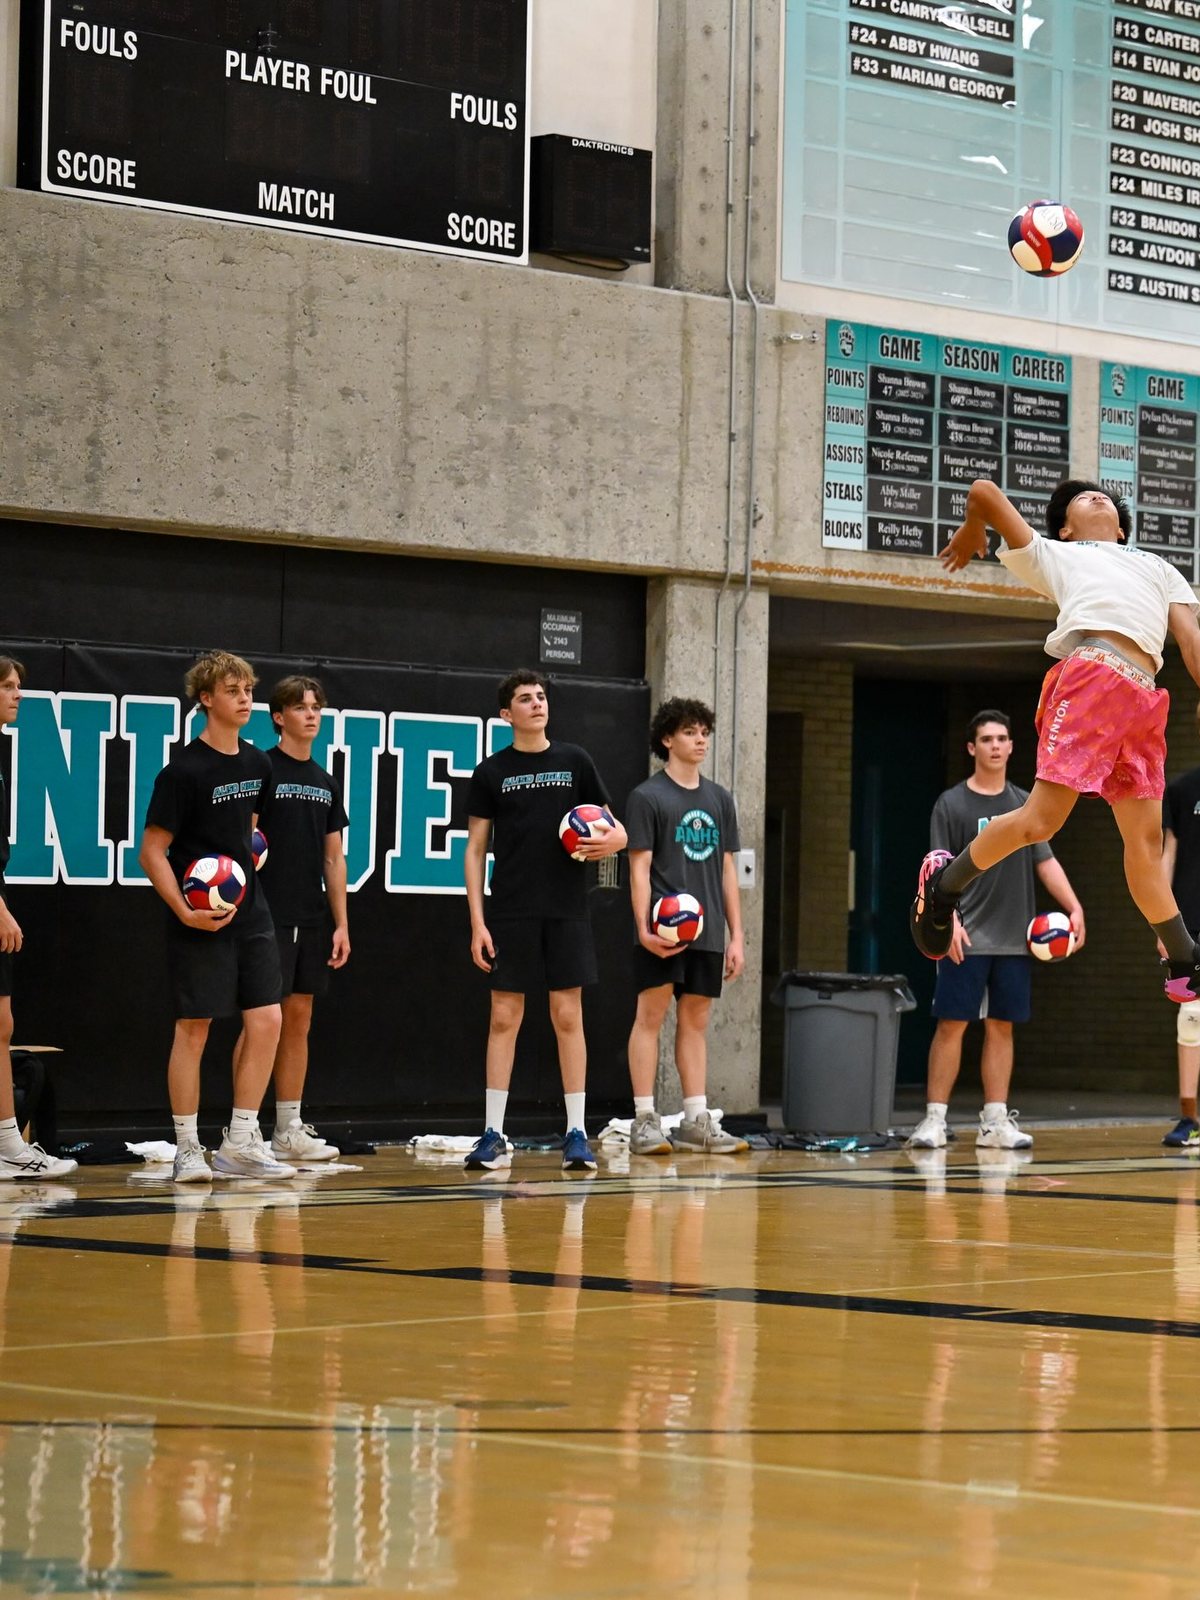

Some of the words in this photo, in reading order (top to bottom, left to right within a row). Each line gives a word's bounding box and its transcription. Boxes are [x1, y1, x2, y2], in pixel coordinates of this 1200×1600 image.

[890, 0, 949, 24] CAMRY
[61, 19, 138, 60] FOULS
[851, 26, 877, 44] #24
[889, 36, 926, 55] ABBY
[930, 44, 979, 66] HWANG
[1115, 22, 1139, 38] #13
[1145, 28, 1200, 53] CARTER
[1114, 50, 1137, 68] #14
[1144, 56, 1180, 77] EVAN
[226, 50, 310, 92] PLAYER
[321, 68, 377, 104] FOUL
[853, 57, 878, 74] #33
[891, 64, 946, 88] MARIAM
[949, 77, 1005, 100] GEORGY
[1114, 84, 1137, 101] #20
[451, 92, 517, 130] FOULS
[1114, 112, 1135, 129] #21
[1143, 119, 1180, 139] JOSH
[572, 138, 634, 156] DAKTRONICS
[1112, 147, 1135, 164] #23
[57, 150, 136, 189] SCORE
[1112, 176, 1135, 193] #24
[1142, 180, 1183, 201] MILES
[258, 182, 334, 220] MATCH
[447, 212, 516, 250] SCORE
[1112, 210, 1135, 227] #32
[1141, 215, 1196, 238] BRANDON
[1111, 238, 1134, 254] #34
[1140, 244, 1195, 267] JAYDON
[1110, 274, 1133, 291] #35
[1139, 278, 1188, 300] AUSTIN
[879, 334, 922, 362] GAME
[944, 344, 1000, 374] SEASON
[1012, 355, 1065, 383] CAREER
[827, 368, 864, 388] POINTS
[904, 376, 926, 389] Brown
[882, 386, 892, 396] 47
[974, 386, 996, 398] Brown
[1147, 374, 1185, 402] GAME
[950, 395, 965, 407] 692
[1013, 404, 1031, 416] 1682
[1038, 396, 1060, 408] Brown
[827, 405, 864, 426] REBOUNDS
[902, 413, 924, 426] Brown
[1101, 407, 1134, 427] POINTS
[1141, 410, 1161, 424] Dylan
[880, 422, 891, 433] 30
[972, 423, 994, 435] Brown
[1014, 440, 1032, 451] 1016
[1039, 432, 1060, 444] Brown
[826, 444, 863, 464] ASSISTS
[872, 447, 895, 459] Nicole
[896, 450, 928, 464] Referente
[944, 455, 969, 467] Hannah
[1101, 443, 1134, 461] REBOUNDS
[881, 460, 890, 471] 15
[950, 467, 964, 478] 145
[1019, 476, 1032, 486] 434
[825, 481, 862, 502] STEALS
[880, 485, 899, 498] Abby
[900, 488, 922, 500] Miller
[884, 497, 892, 508] 14
[1019, 502, 1036, 516] Abby
[824, 520, 862, 540] BLOCKS
[878, 522, 900, 536] Reilly
[902, 525, 923, 538] Hefty
[882, 535, 891, 546] 16
[542, 622, 580, 632] OCCUPANCY
[546, 649, 575, 660] PERSONS
[1046, 700, 1071, 756] MENTOR
[212, 782, 239, 798] ALISO
[502, 774, 534, 788] ALISO
[2, 690, 515, 896] NIUE
[675, 826, 720, 845] ANHS
